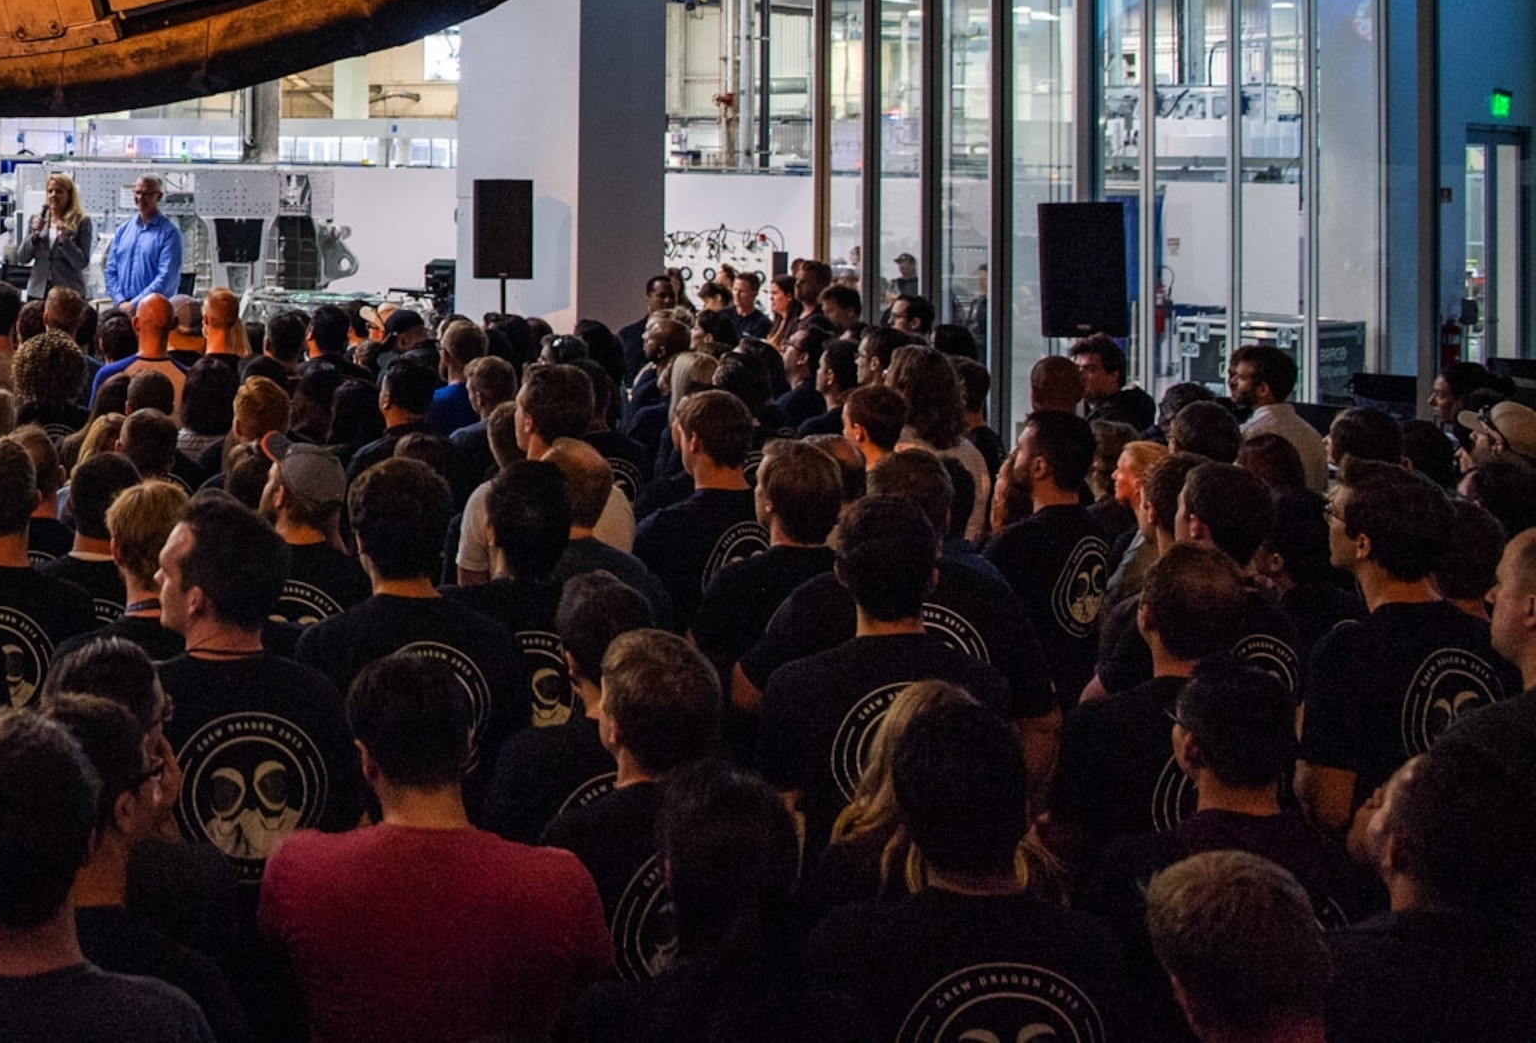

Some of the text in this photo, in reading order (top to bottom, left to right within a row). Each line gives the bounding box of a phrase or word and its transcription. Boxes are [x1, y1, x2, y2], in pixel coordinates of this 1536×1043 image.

[196, 727, 224, 753] CREW
[227, 720, 275, 734] DRAGON
[936, 979, 973, 1010] CREW
[978, 972, 1041, 989] DRAGON
